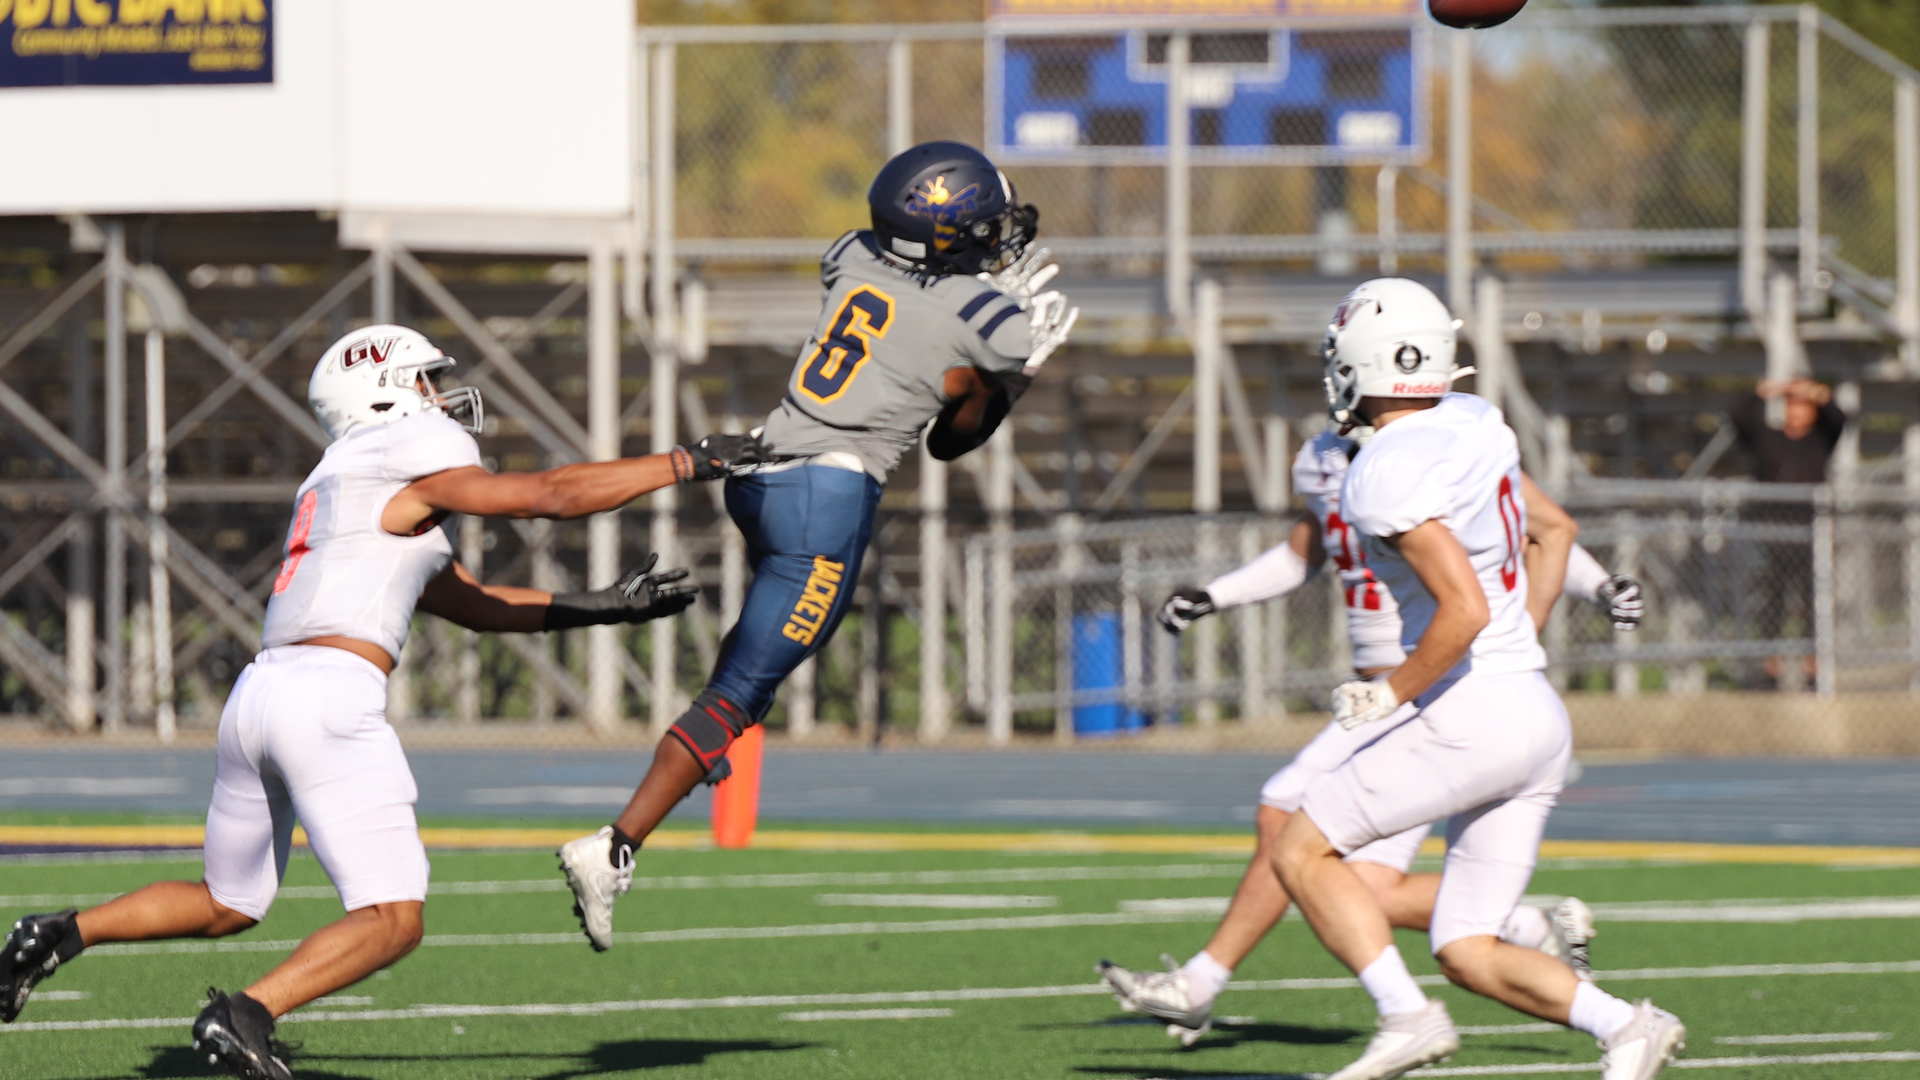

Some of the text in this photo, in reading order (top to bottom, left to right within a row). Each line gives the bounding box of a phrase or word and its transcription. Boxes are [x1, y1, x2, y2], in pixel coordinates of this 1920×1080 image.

[342, 334, 402, 371] GV
[797, 283, 896, 405] 6
[1498, 475, 1522, 592] 0
[782, 554, 845, 647] JACKETS
